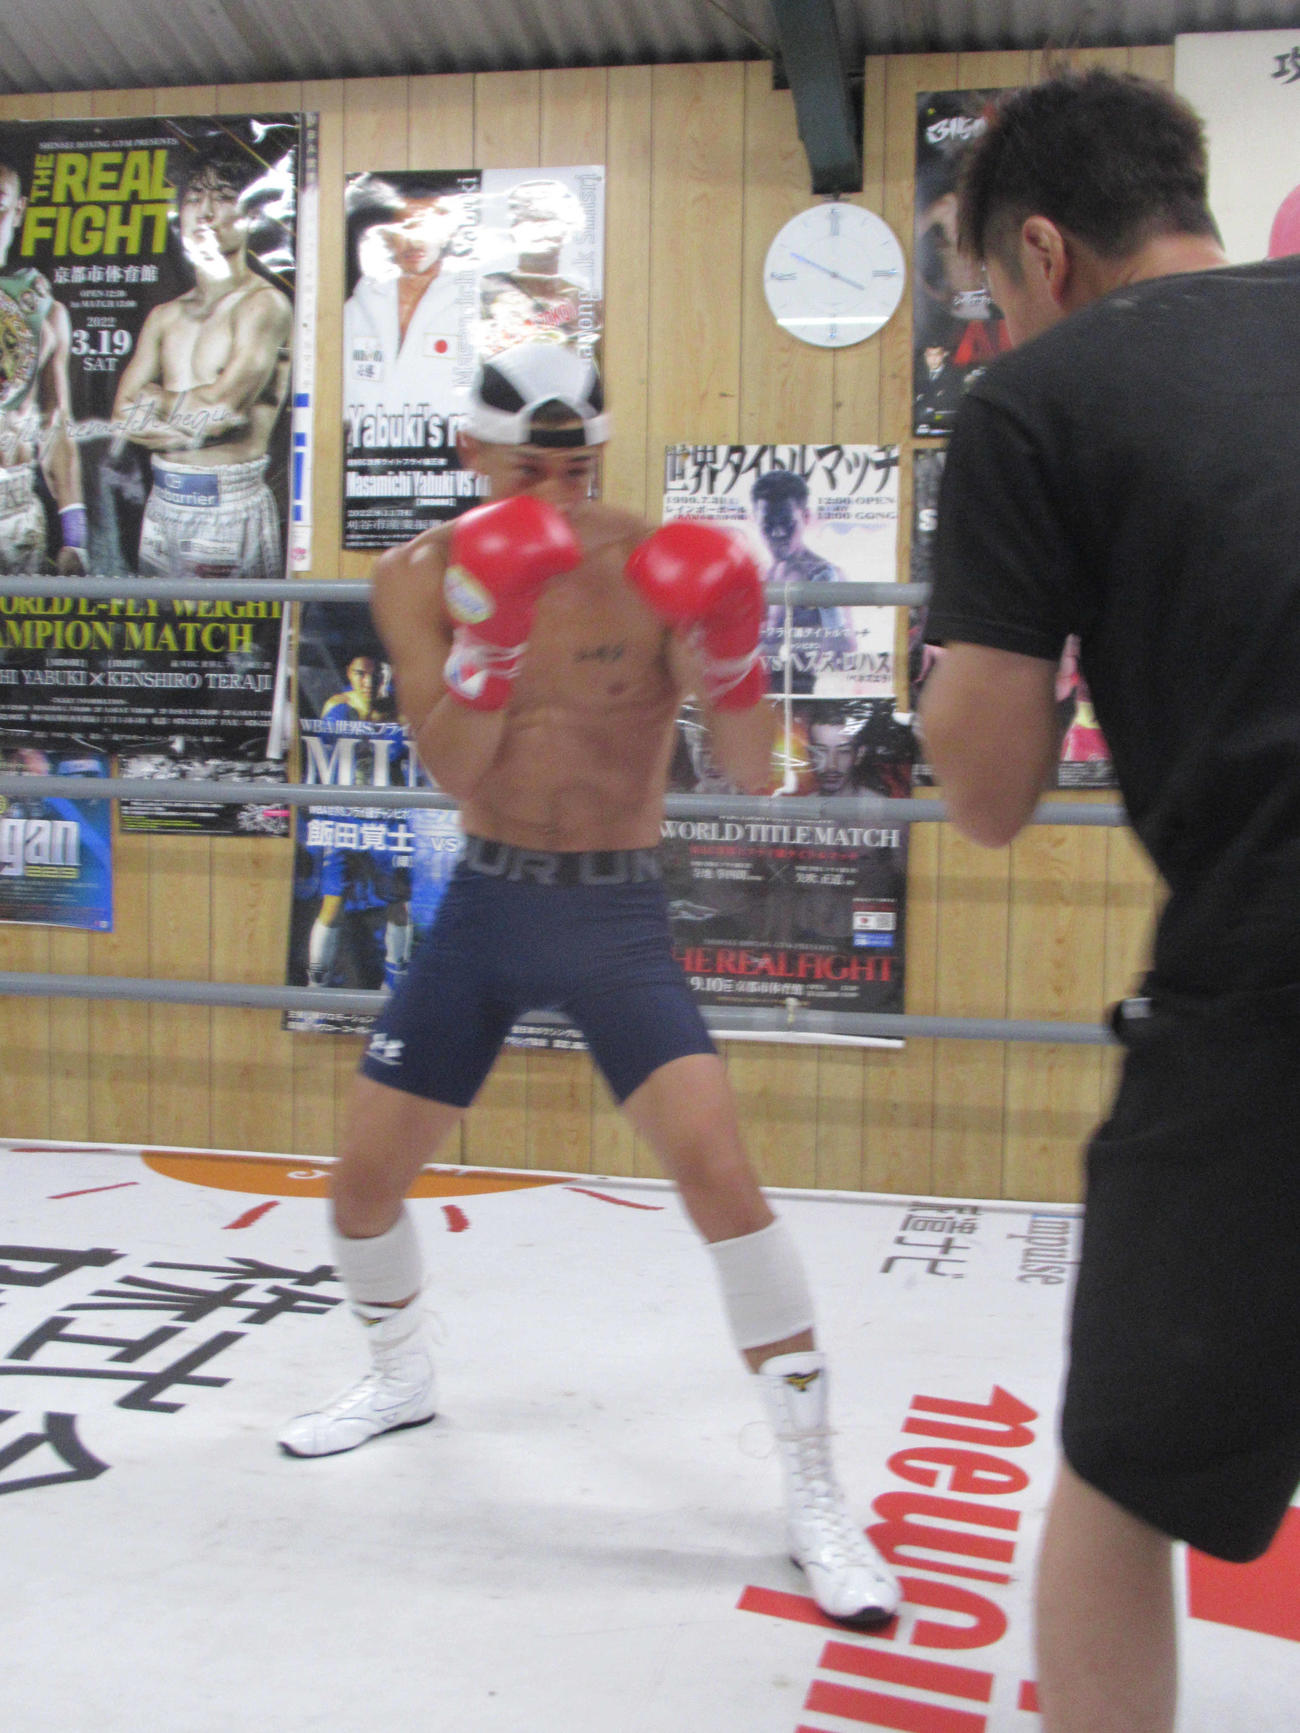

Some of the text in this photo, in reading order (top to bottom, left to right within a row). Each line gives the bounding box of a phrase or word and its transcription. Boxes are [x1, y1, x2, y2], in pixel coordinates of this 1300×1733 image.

[31, 149, 177, 203] THE REAL
[20, 202, 179, 257] FIGHT
[86, 316, 117, 328] 2022
[71, 329, 133, 355] 3.19
[83, 357, 119, 371] SAT
[349, 403, 444, 448] Yabuki's
[664, 444, 899, 496] 世界タイトルマッチ
[414, 471, 456, 497] Yabuki
[457, 471, 476, 497] VS
[855, 496, 896, 505] OPEN
[854, 511, 897, 520] GONG
[173, 599, 283, 619] WEIGHT
[124, 621, 255, 654] MATCH
[21, 669, 88, 686] YABUKI
[107, 671, 203, 688] KENSHIRO
[205, 673, 273, 692] TERAJI
[430, 836, 461, 853] VS
[661, 819, 744, 842] WORLD
[745, 824, 812, 845] TITLE
[812, 827, 900, 849] MATCH
[710, 949, 797, 978] REAL
[798, 955, 900, 981] FIGHT
[690, 976, 723, 992] 9.10
